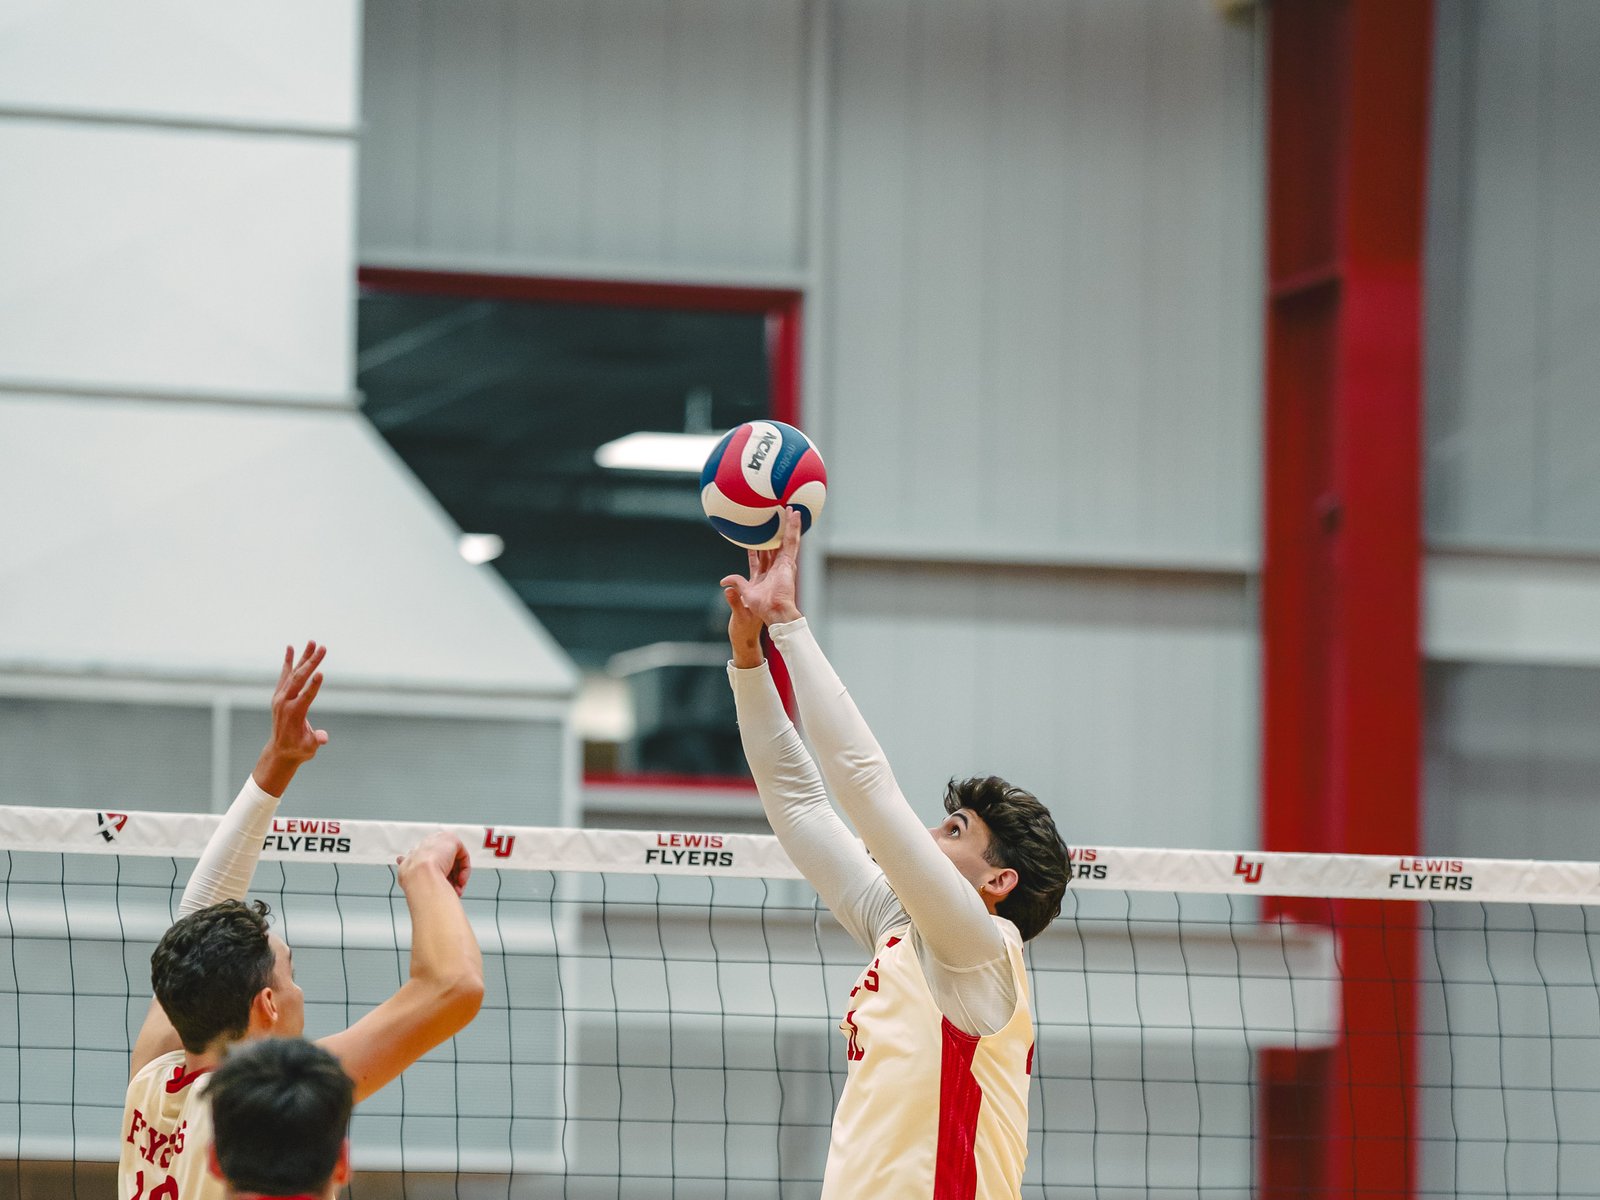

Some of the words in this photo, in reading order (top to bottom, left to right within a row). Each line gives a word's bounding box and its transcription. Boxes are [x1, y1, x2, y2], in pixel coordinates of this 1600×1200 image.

[747, 431, 777, 471] NCAA
[273, 819, 341, 835] LEWIS
[262, 835, 351, 853] FLYERS
[657, 833, 723, 849] LEWIS
[645, 849, 733, 867] FLYERS
[1399, 858, 1463, 873] LEWIS
[1388, 874, 1473, 891] FLYERS
